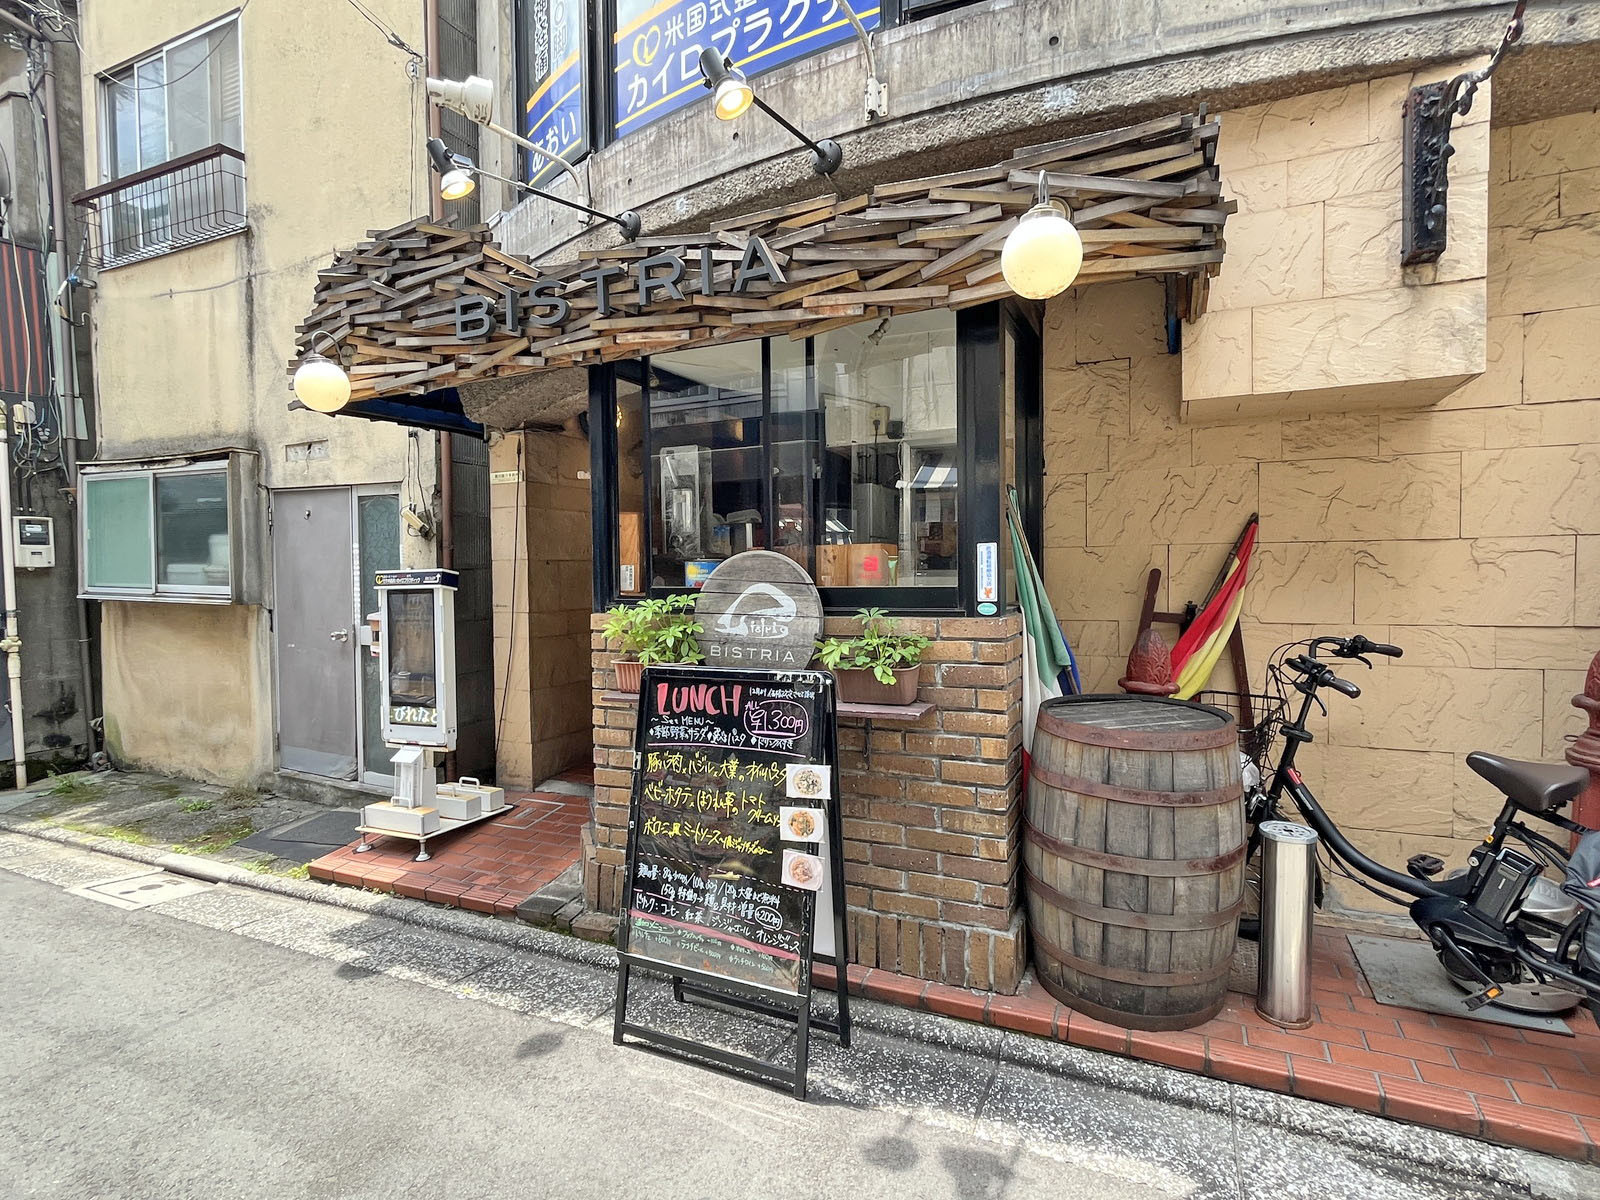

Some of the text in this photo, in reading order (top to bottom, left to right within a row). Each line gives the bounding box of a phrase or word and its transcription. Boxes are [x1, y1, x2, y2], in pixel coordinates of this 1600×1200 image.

[532, 111, 577, 173] あおい
[455, 234, 786, 340] BISTRIA
[710, 645, 795, 662] BISTRIA
[657, 683, 742, 717] LUNCH
[744, 700, 760, 711] ALL
[681, 716, 704, 725] MENU
